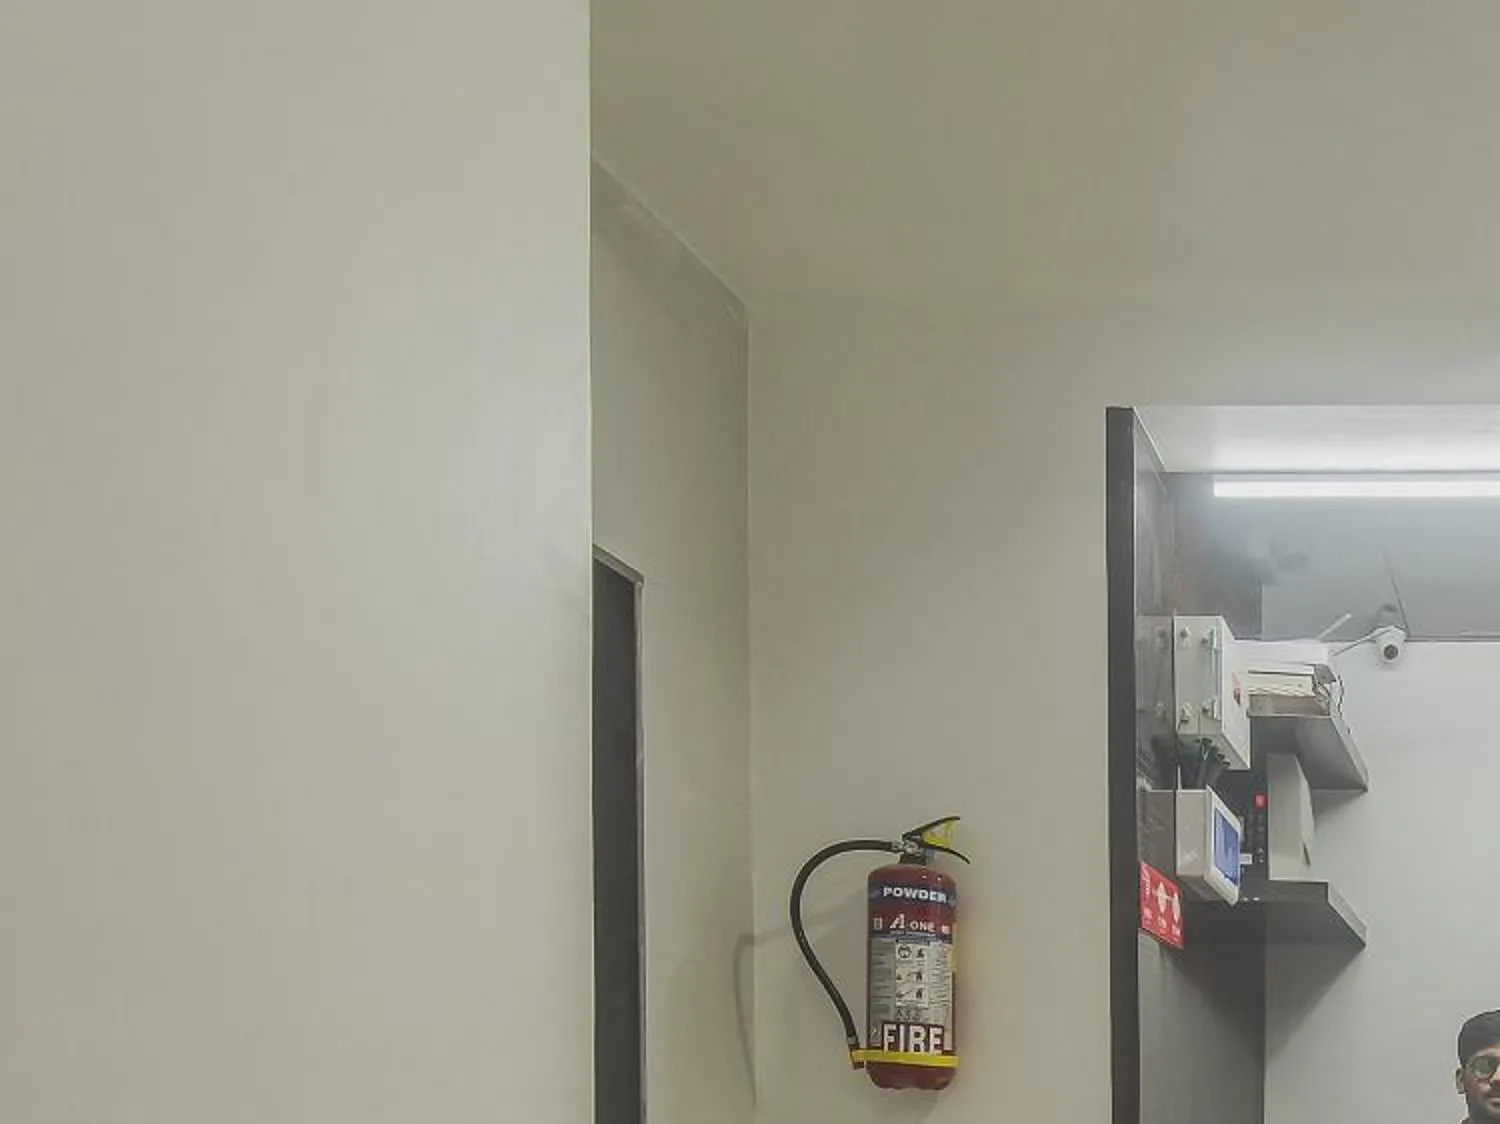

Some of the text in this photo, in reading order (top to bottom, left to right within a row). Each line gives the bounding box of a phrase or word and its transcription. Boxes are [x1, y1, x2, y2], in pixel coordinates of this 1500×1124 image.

[882, 886, 947, 904] POWDER
[889, 913, 936, 933] A ONE
[883, 1024, 943, 1054] FIRE
